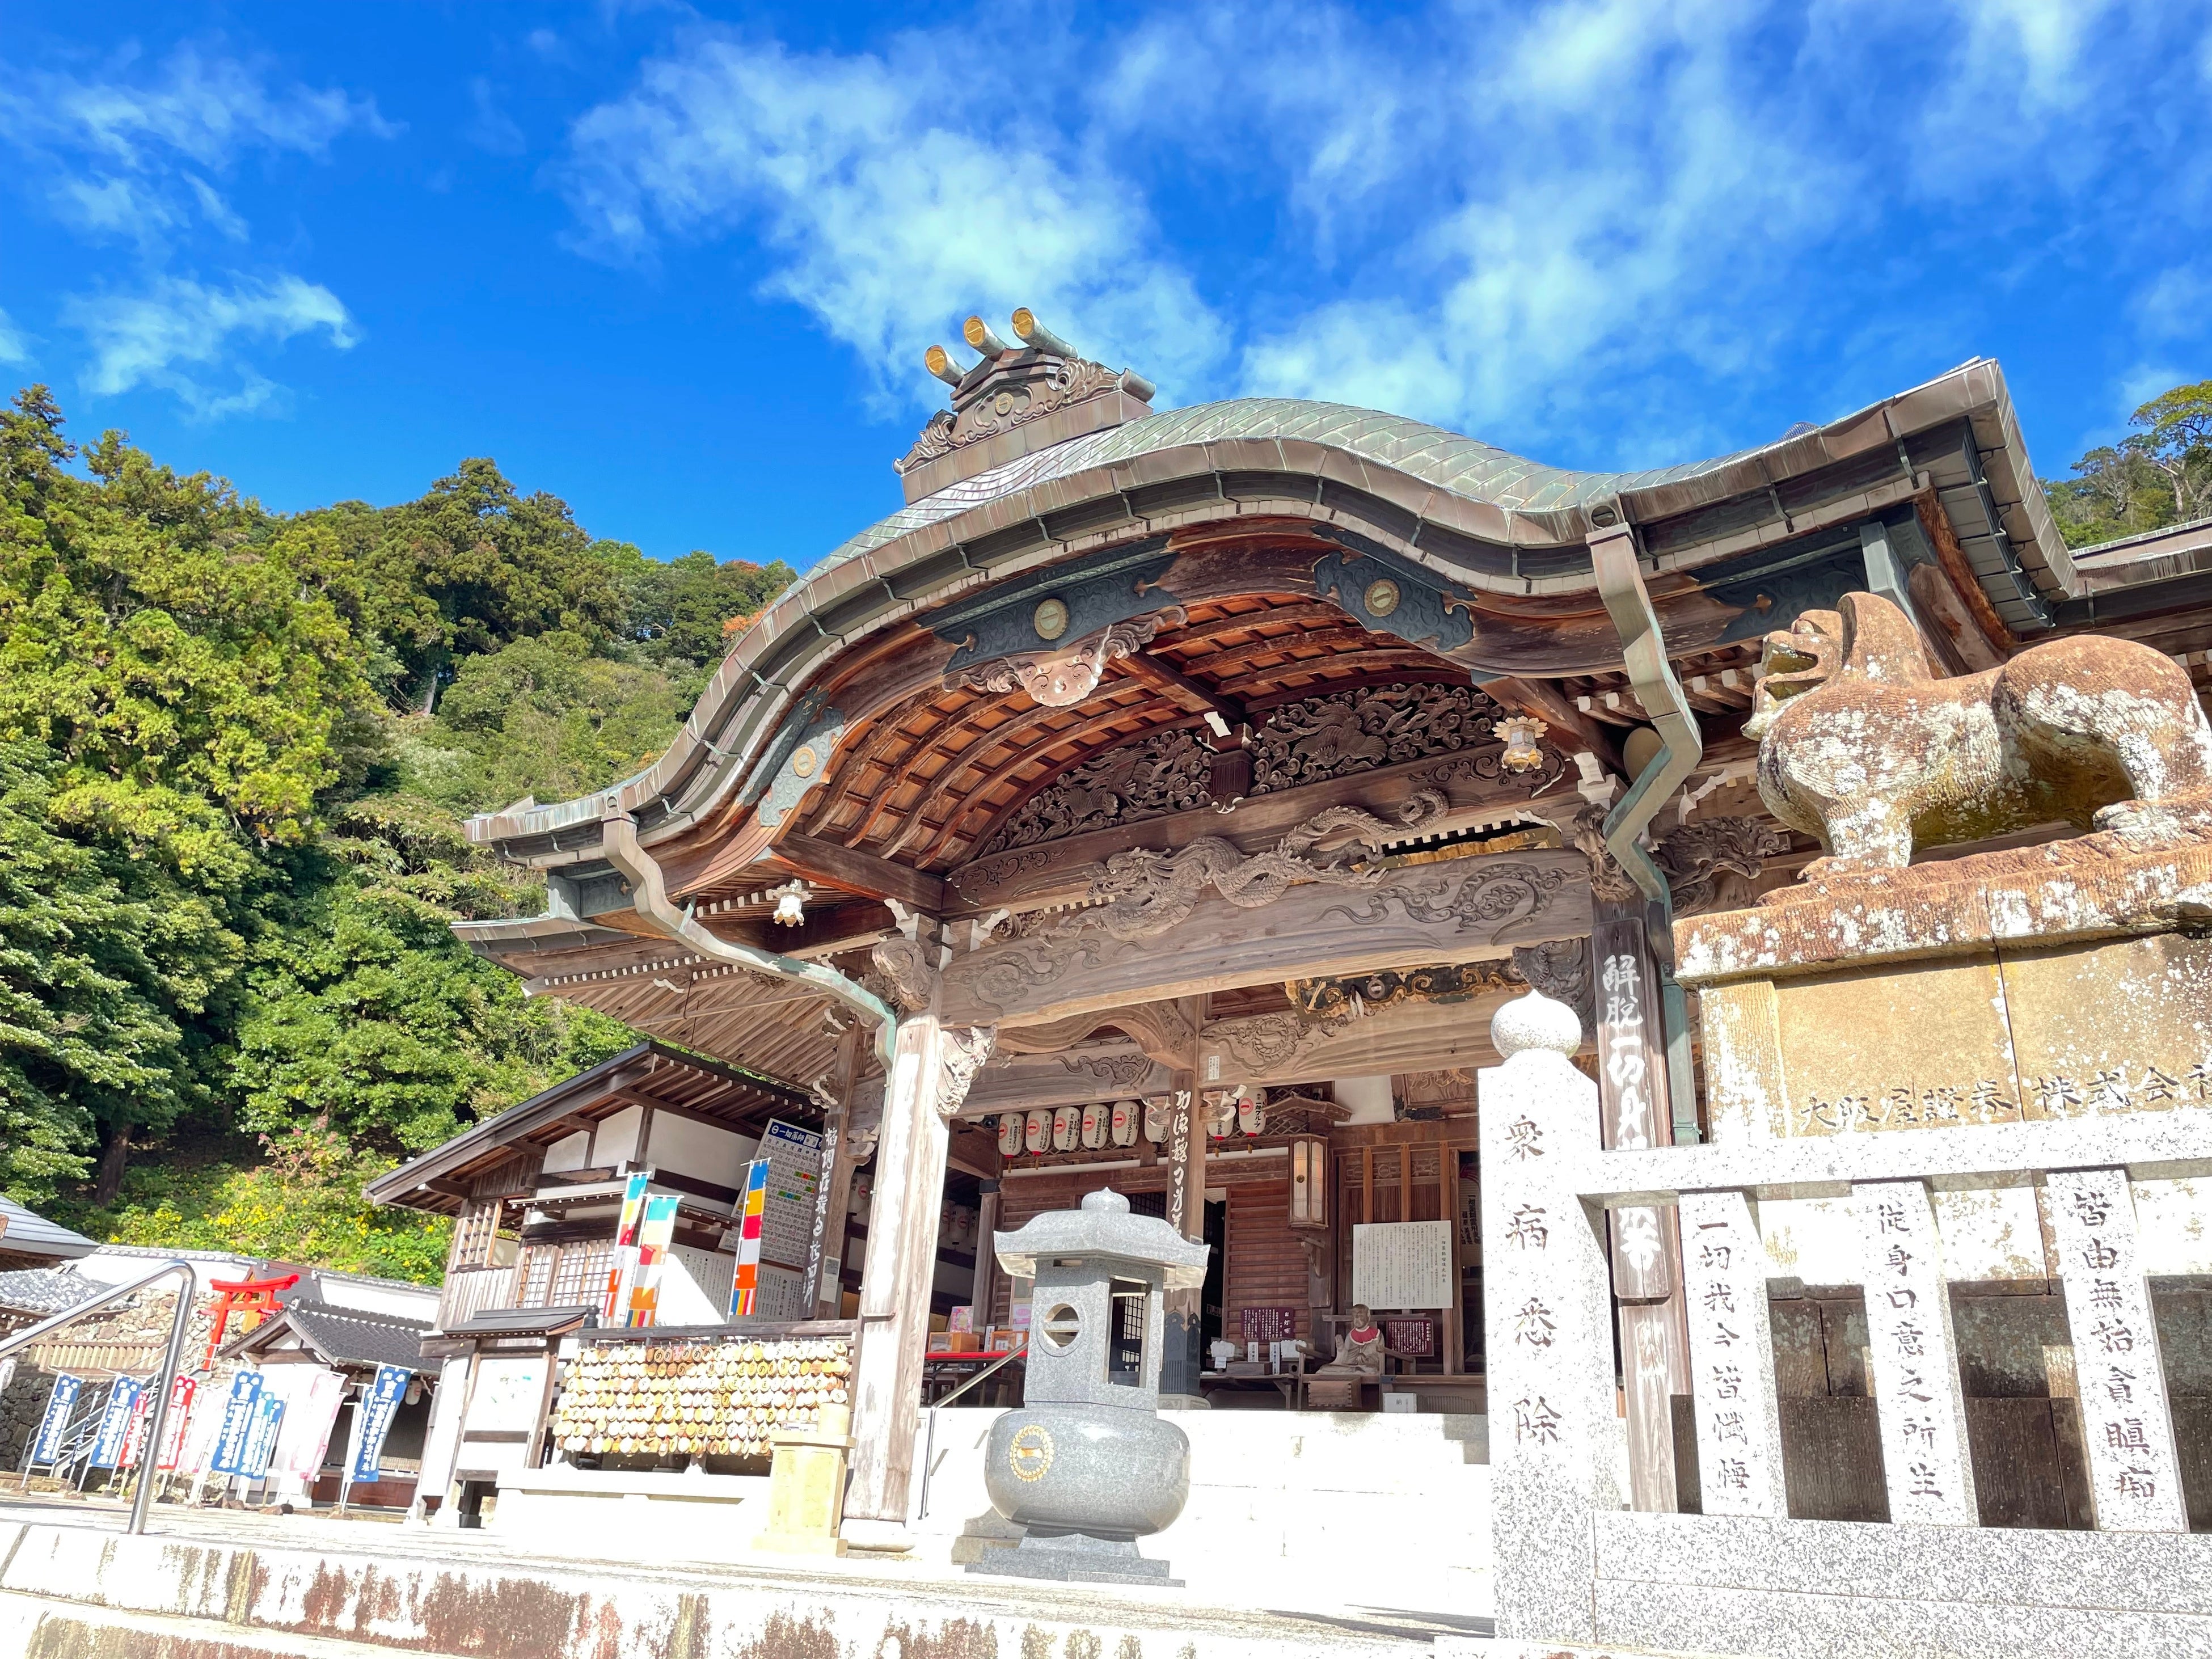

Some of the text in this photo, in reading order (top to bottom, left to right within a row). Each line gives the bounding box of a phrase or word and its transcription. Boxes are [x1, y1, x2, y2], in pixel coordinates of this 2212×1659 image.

[1505, 1114, 1563, 1447] 衆病悉除
[1698, 1222, 1750, 1489] 一切我今皆懺悔
